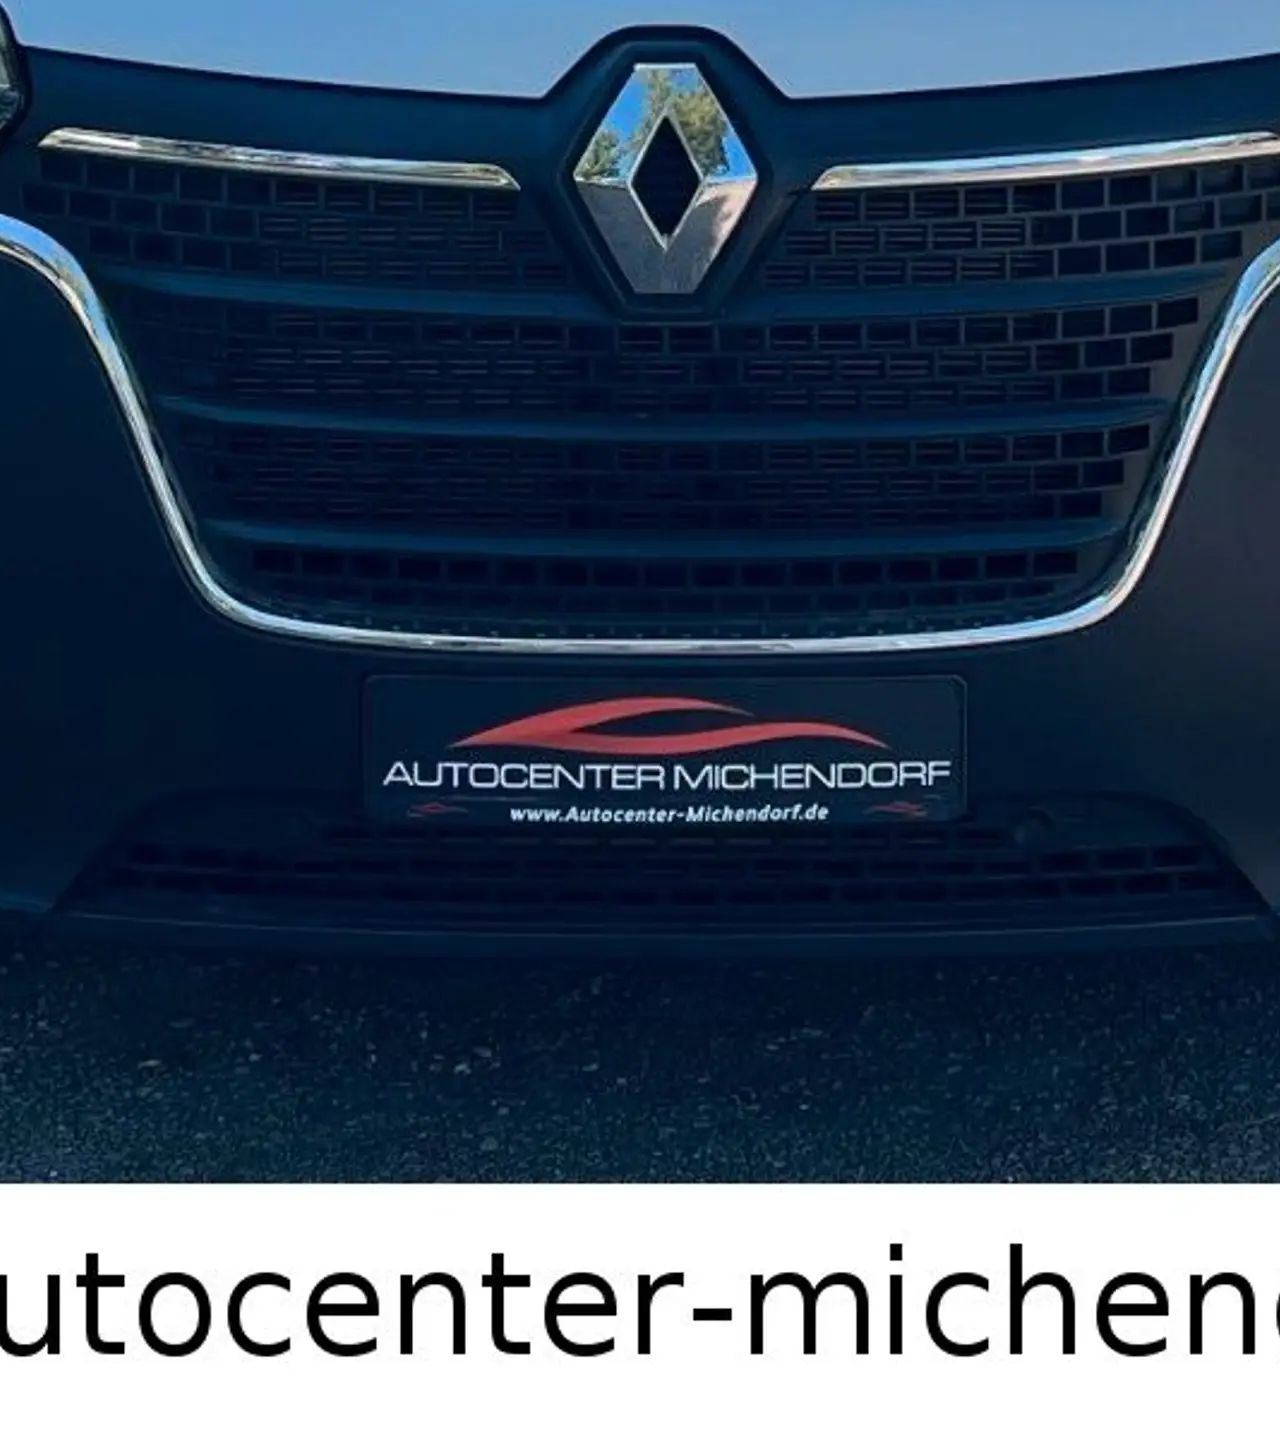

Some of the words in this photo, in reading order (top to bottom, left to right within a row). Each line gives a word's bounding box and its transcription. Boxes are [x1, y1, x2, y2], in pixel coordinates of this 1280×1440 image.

[382, 760, 665, 791] AUTOCENTER
[672, 759, 951, 790] MICHENDORF
[509, 801, 829, 824] www.Autocenter-Michendorf.de
